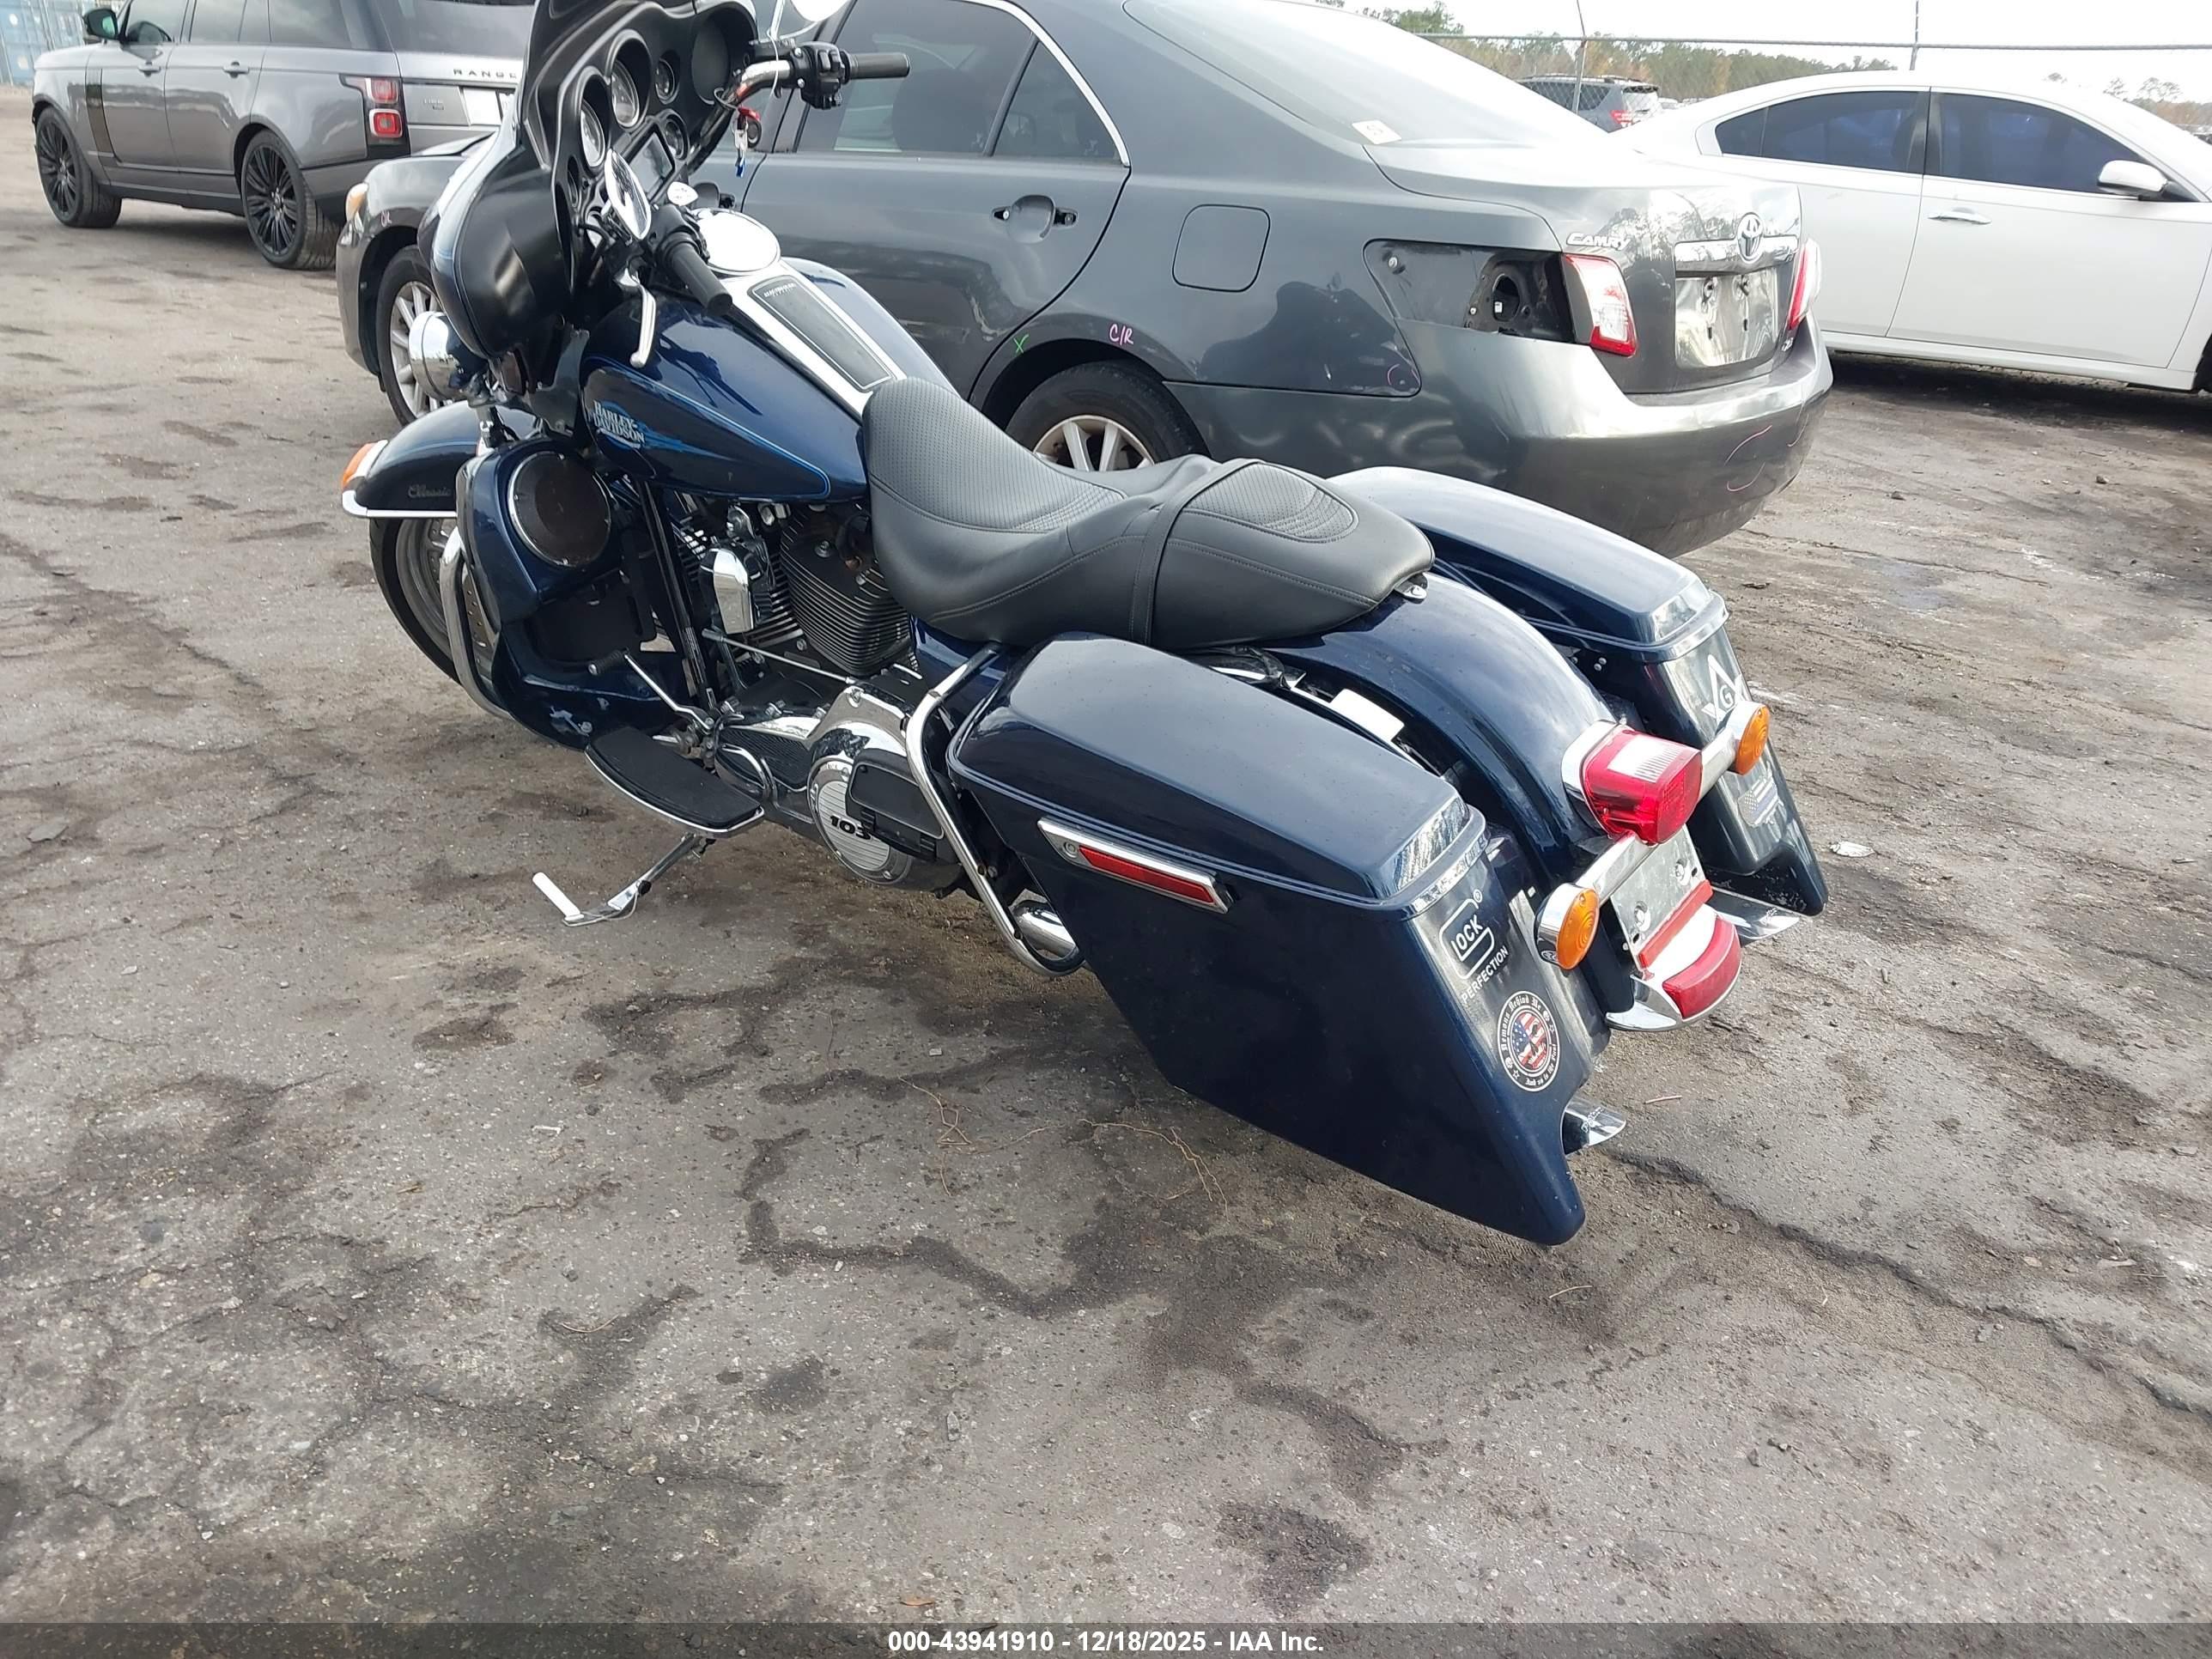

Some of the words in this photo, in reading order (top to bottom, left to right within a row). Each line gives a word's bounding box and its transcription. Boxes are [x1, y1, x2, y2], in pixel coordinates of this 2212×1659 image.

[453, 69, 517, 79] RANGE
[1565, 232, 1632, 251] CAMRY
[1109, 323, 1134, 345] C/R
[1719, 684, 1735, 708] G
[830, 815, 872, 840] 103
[1461, 945, 1509, 1004] PERFECTION
